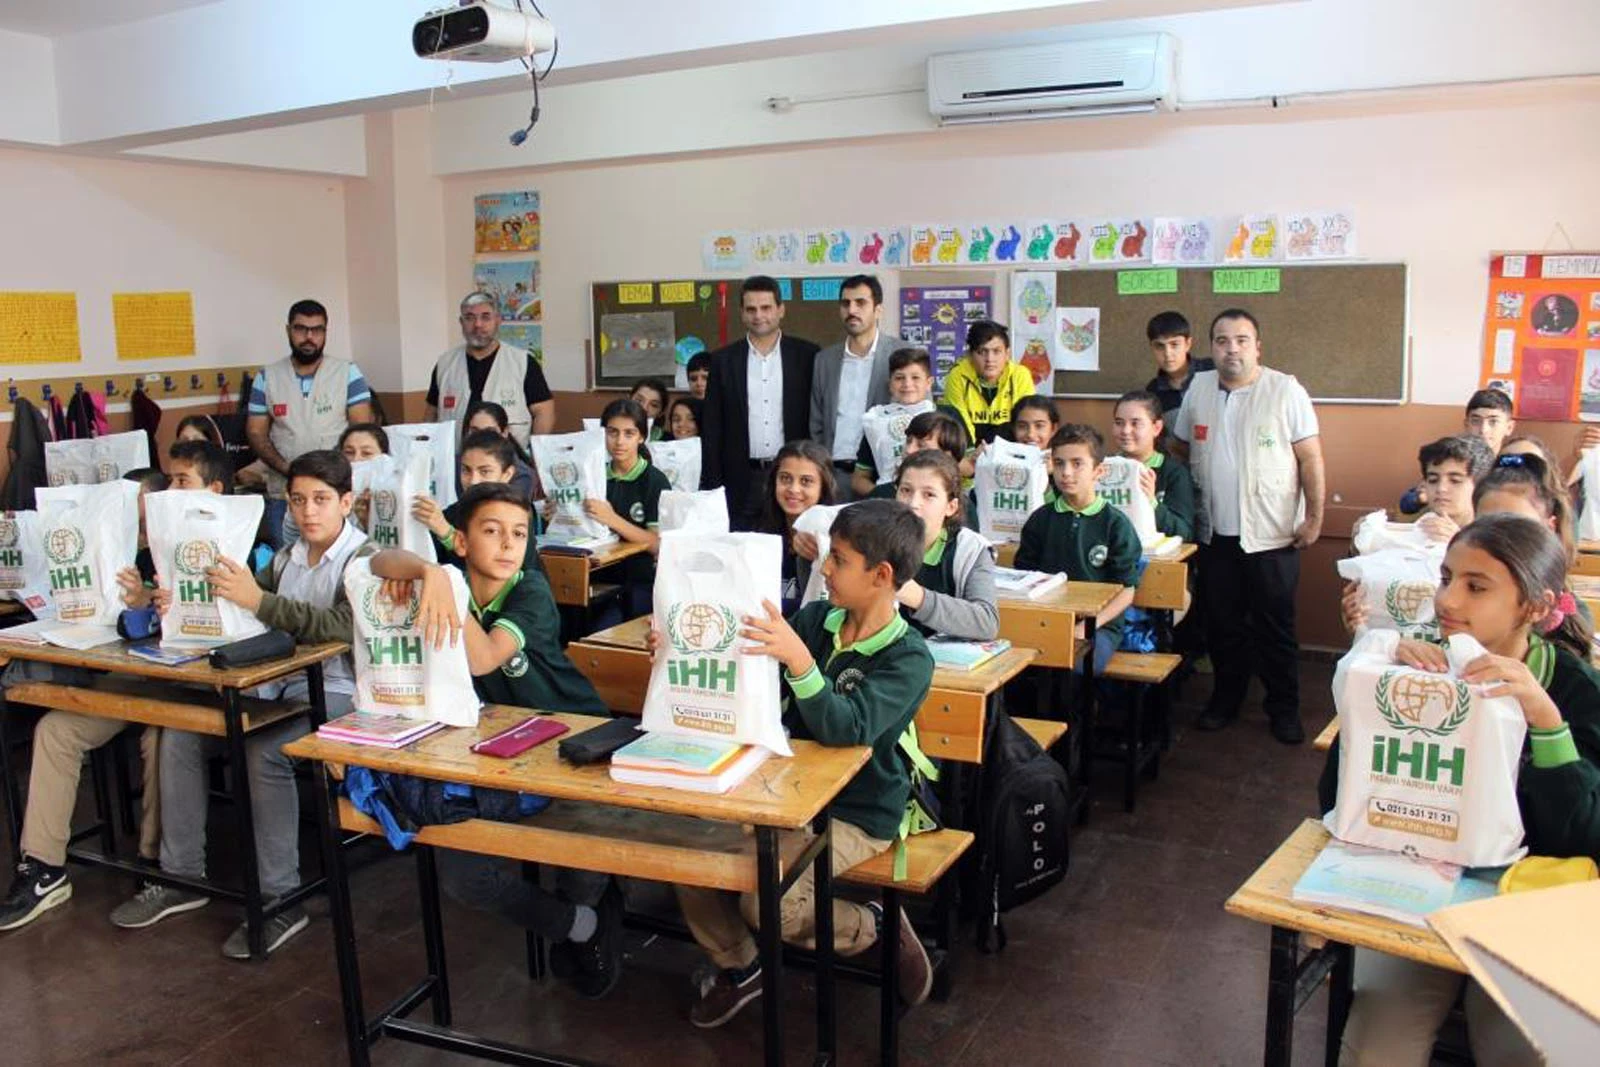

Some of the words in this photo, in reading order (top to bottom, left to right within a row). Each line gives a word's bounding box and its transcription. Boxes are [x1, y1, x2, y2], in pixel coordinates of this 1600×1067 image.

[1506, 257, 1522, 275] 15
[1216, 269, 1278, 291] SANATLAR
[622, 284, 651, 300] TEMA
[1409, 807, 1425, 818] 631
[1427, 811, 1438, 820] 21
[1440, 813, 1452, 823] 21
[1032, 803, 1046, 871] POLO
